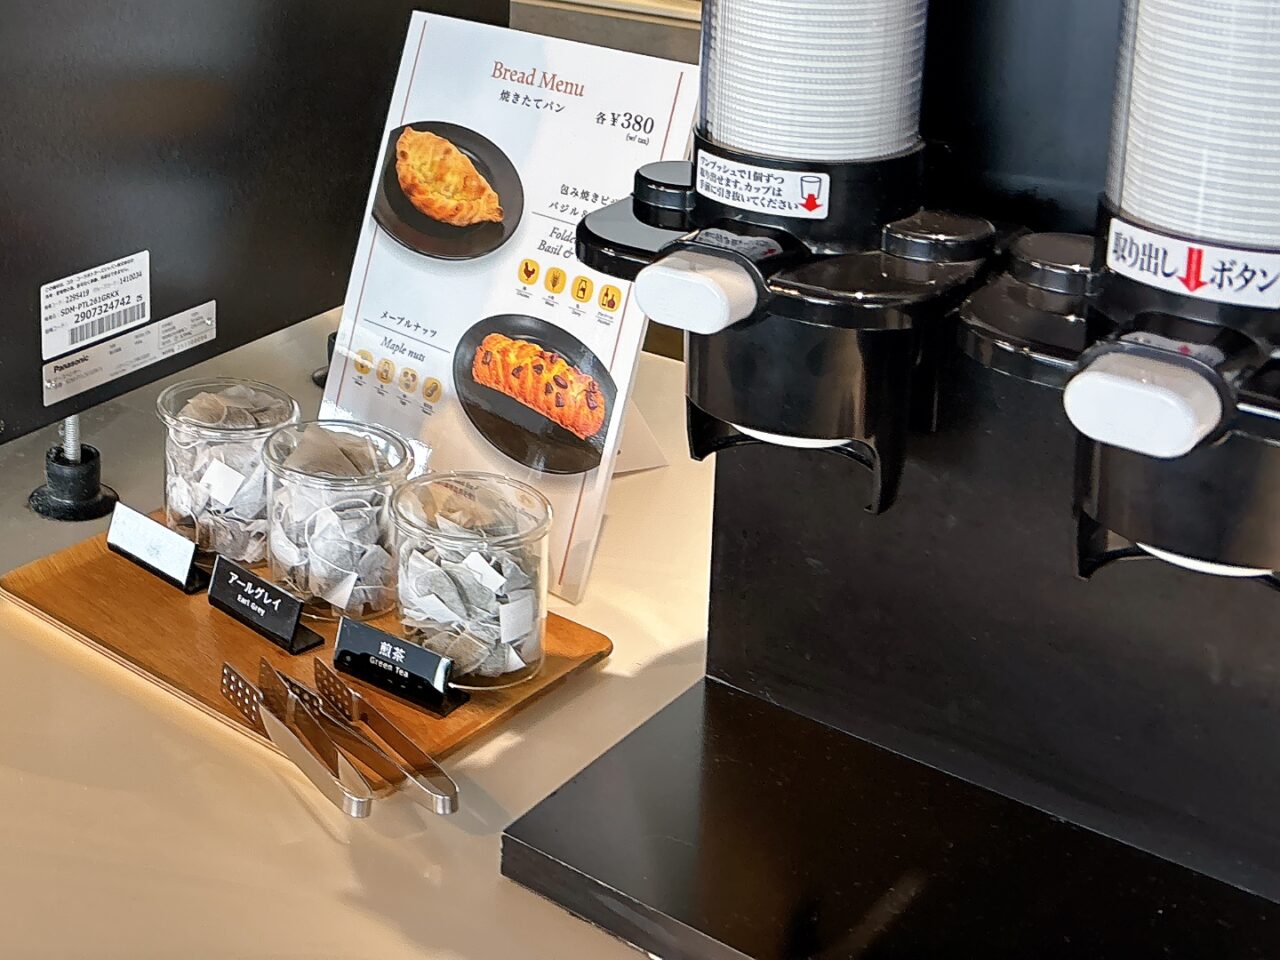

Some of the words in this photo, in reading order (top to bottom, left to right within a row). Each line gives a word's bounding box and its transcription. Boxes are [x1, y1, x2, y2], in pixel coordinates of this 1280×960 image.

[491, 61, 536, 86] Bread
[537, 71, 585, 97] Menu
[499, 89, 566, 114] 焼きたてパン
[700, 156, 785, 185] ワンプッシュで1個ずつ
[537, 239, 564, 256] Basil
[562, 247, 575, 259] &
[1113, 231, 1178, 278] 取り出し
[1210, 258, 1280, 293] ボタン
[74, 295, 131, 324] 2907324742
[380, 310, 437, 338] メープルナッツ
[380, 336, 407, 355] Maple
[408, 349, 426, 362] nuts
[53, 354, 89, 374] Panasonic
[228, 571, 282, 611] アールグレイ
[237, 594, 251, 607] Earl
[250, 602, 266, 617] Grey
[378, 641, 406, 664] 煎茶
[369, 656, 393, 672] Green
[395, 666, 409, 679] Tea
